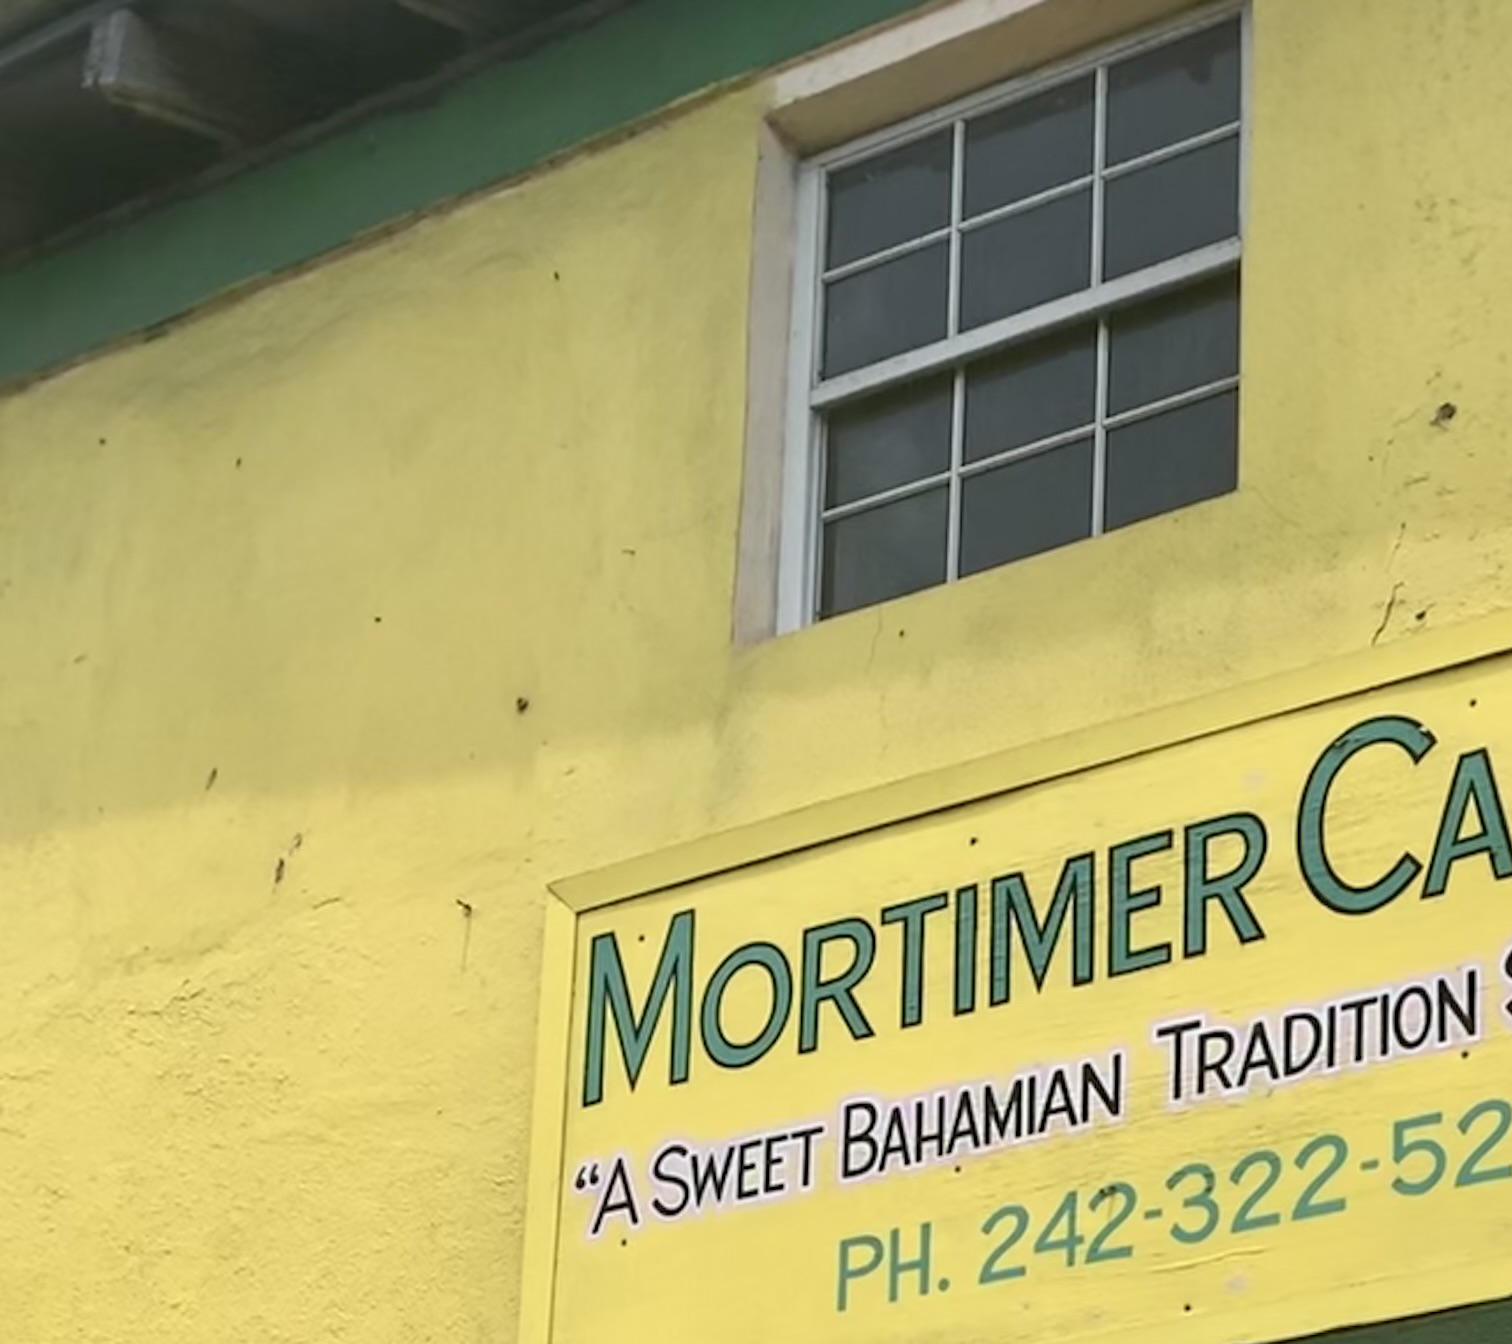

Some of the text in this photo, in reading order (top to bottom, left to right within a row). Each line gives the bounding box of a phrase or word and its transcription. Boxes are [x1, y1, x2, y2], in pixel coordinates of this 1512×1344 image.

[582, 811, 1268, 1107] MORTIMER
[573, 1158, 639, 1235] “A
[651, 1126, 824, 1217] SWEET
[840, 1053, 1123, 1179] BAHAMIAN
[1156, 969, 1477, 1101] TRADITION
[836, 1222, 951, 1312] PH.
